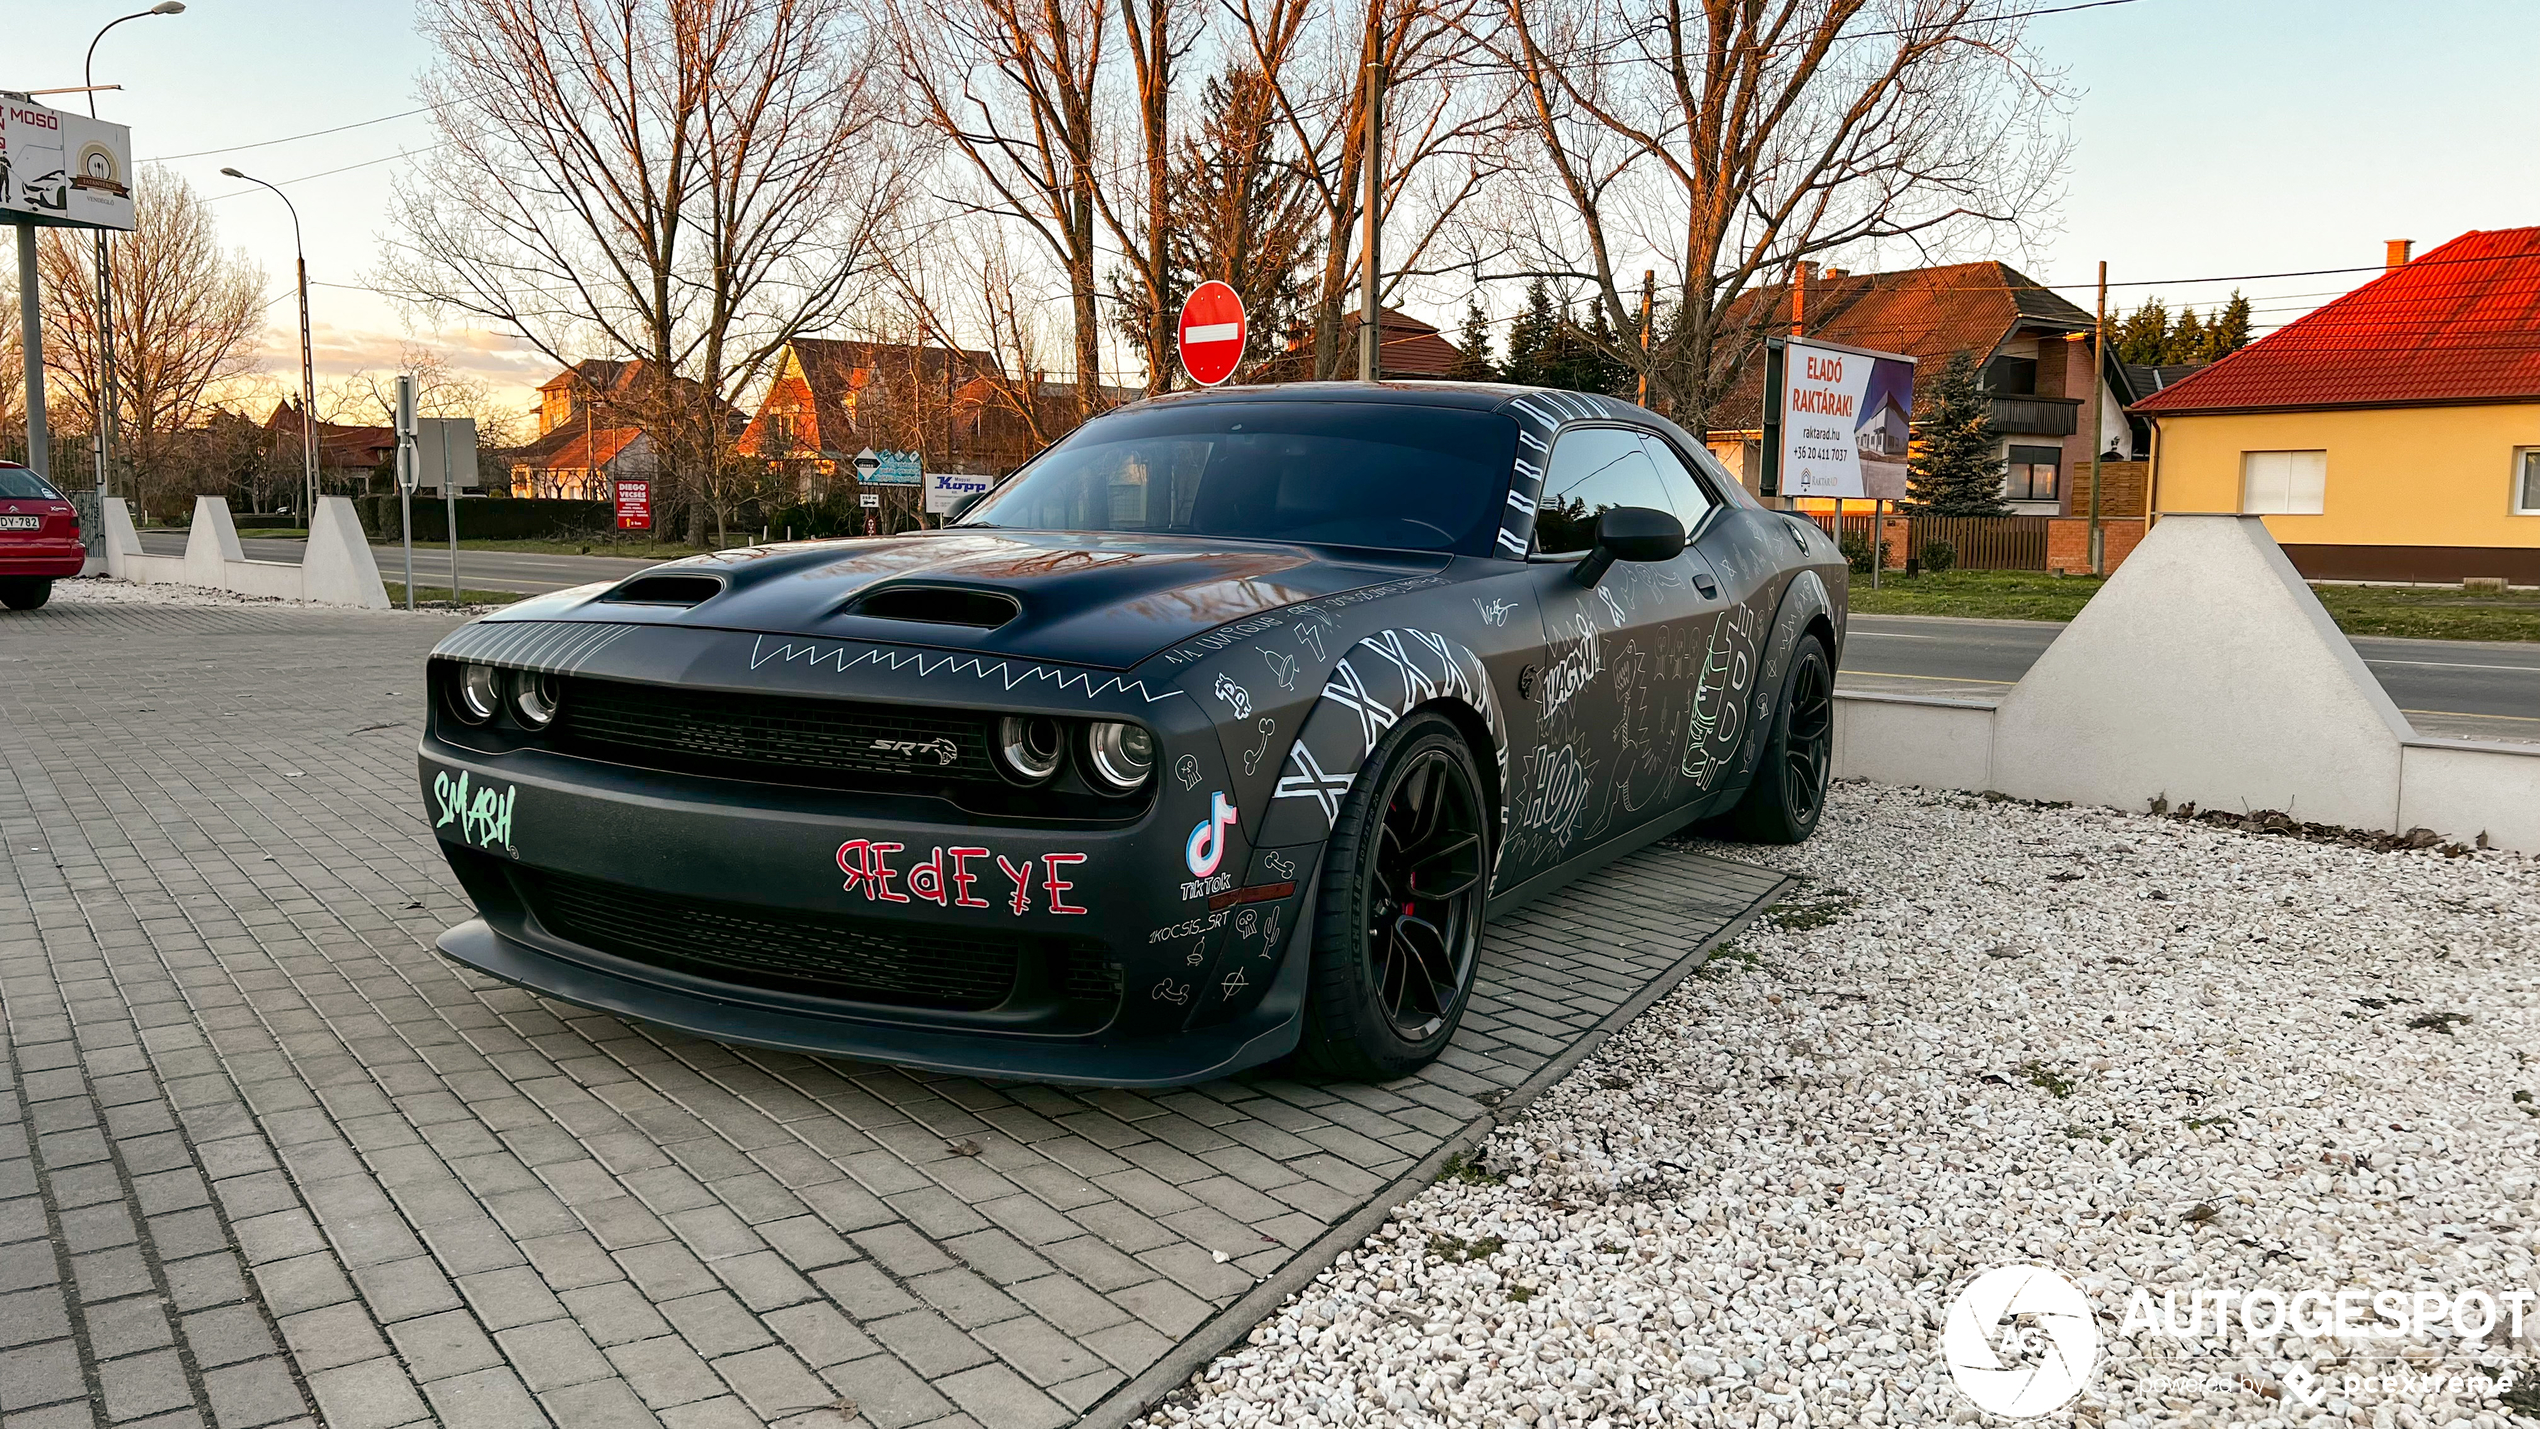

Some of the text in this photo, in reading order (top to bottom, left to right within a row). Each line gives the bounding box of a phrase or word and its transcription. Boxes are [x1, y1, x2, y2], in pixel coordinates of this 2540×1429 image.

[10, 106, 58, 131] MOSÓ
[1807, 356, 1842, 383] ELADÓ
[1792, 388, 1853, 418] RAKTÁRAK!
[1803, 426, 1840, 441] raktarad.hu
[1793, 446, 1848, 462] +36 20 411 7037
[935, 476, 986, 492] Kopp
[869, 739, 938, 757] SRT
[434, 769, 516, 852] SMASH
